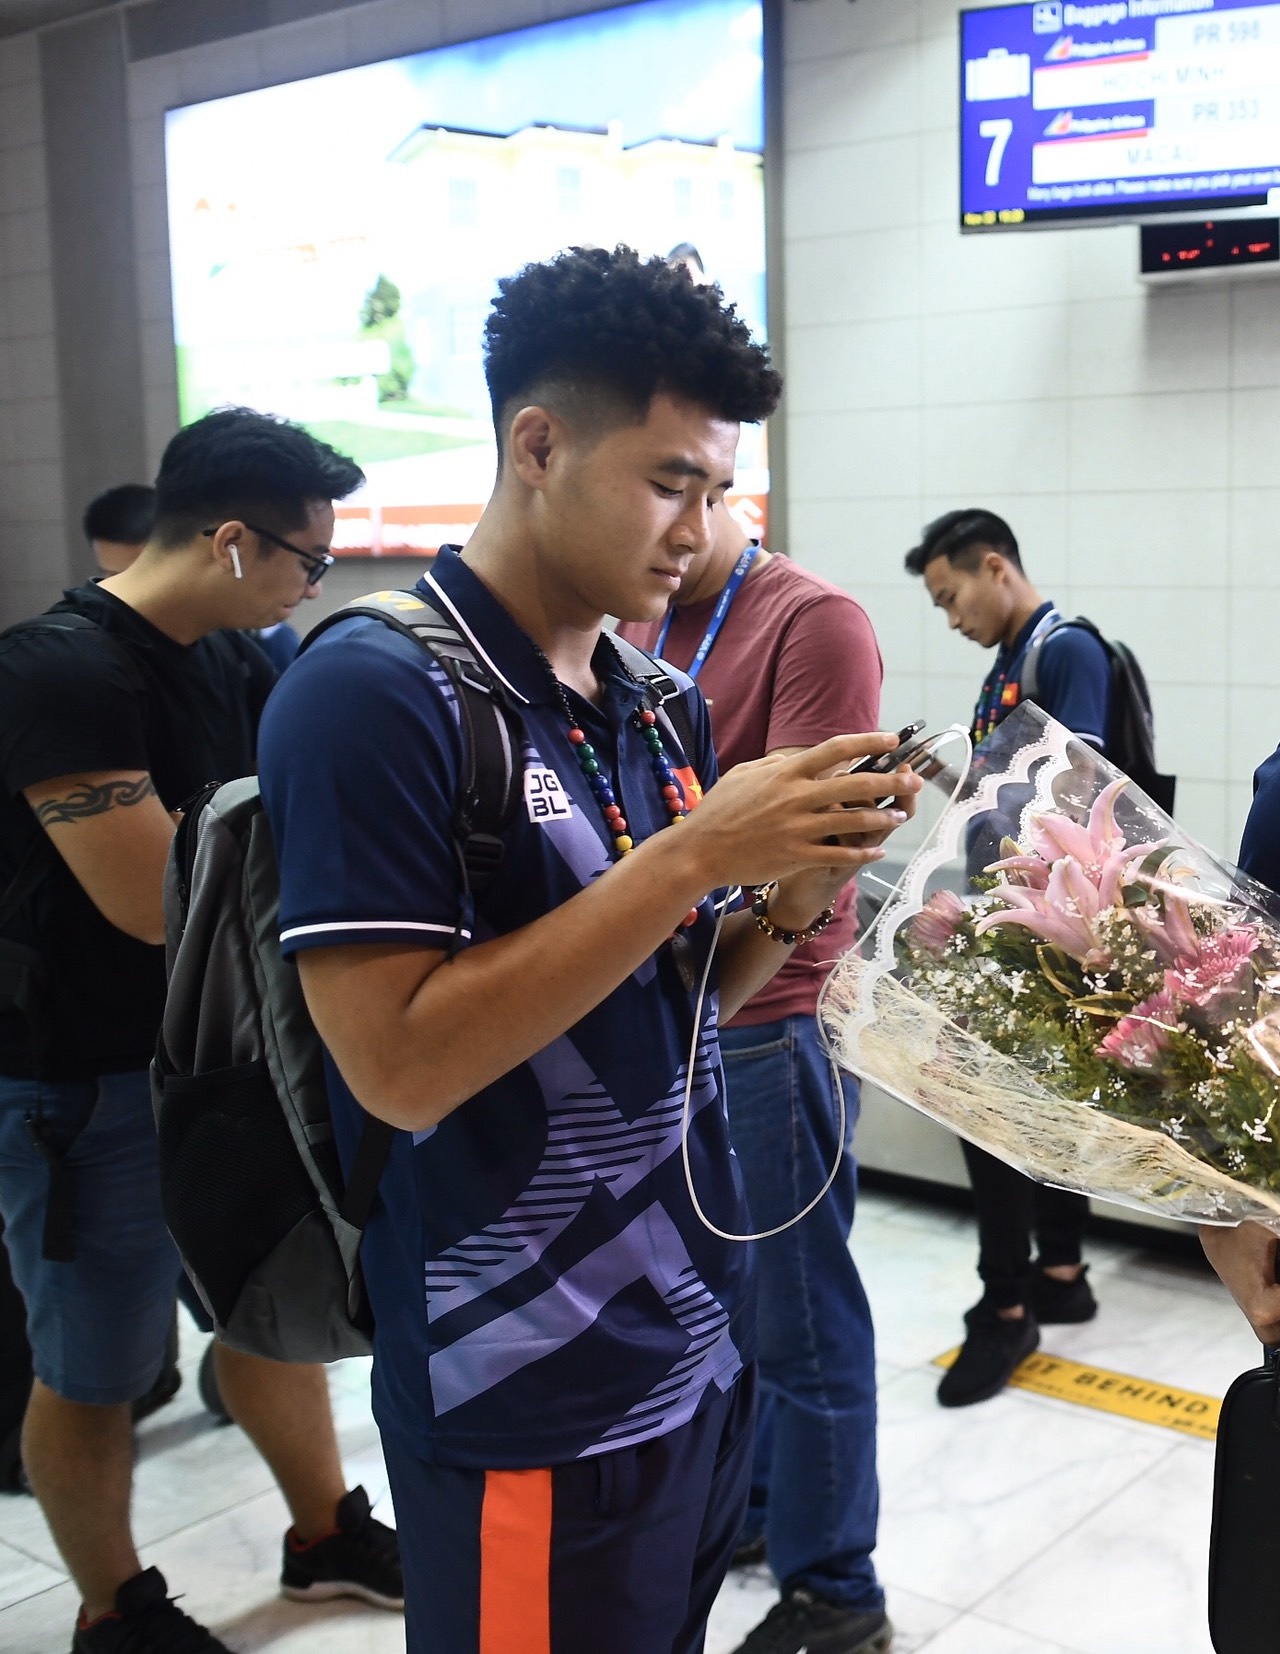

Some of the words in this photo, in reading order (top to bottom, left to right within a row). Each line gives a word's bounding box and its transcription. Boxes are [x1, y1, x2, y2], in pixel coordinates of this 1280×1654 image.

[979, 118, 1013, 187] 7
[530, 774, 559, 794] JG
[531, 796, 567, 817] BL
[1073, 1371, 1209, 1415] BEHIND
